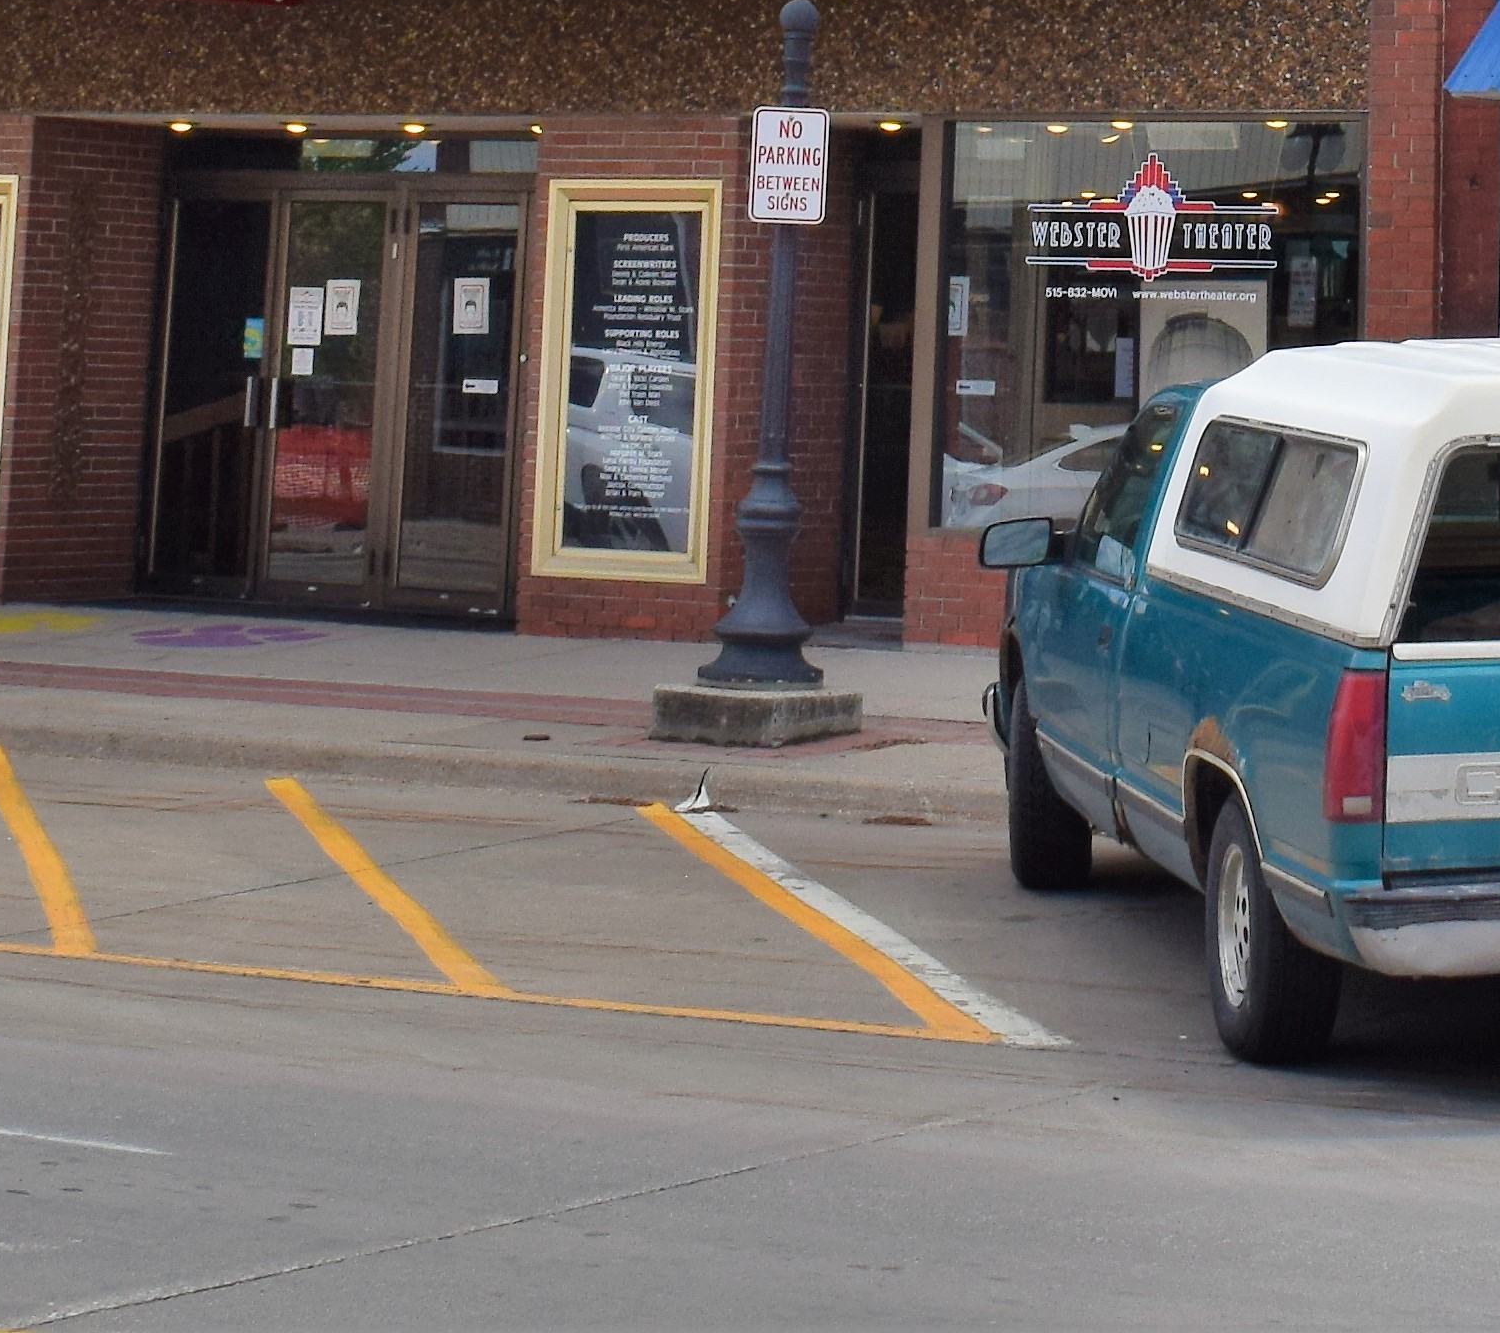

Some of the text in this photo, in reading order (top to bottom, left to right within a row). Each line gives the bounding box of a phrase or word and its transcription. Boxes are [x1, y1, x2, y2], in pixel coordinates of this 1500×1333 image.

[779, 119, 803, 139] NO
[757, 145, 821, 167] PARKING
[756, 175, 820, 192] BETWEEN
[767, 195, 807, 212] SIGNS
[1030, 220, 1272, 251] WEBSTER THEATER
[1132, 290, 1257, 303] www.webstertheater.org
